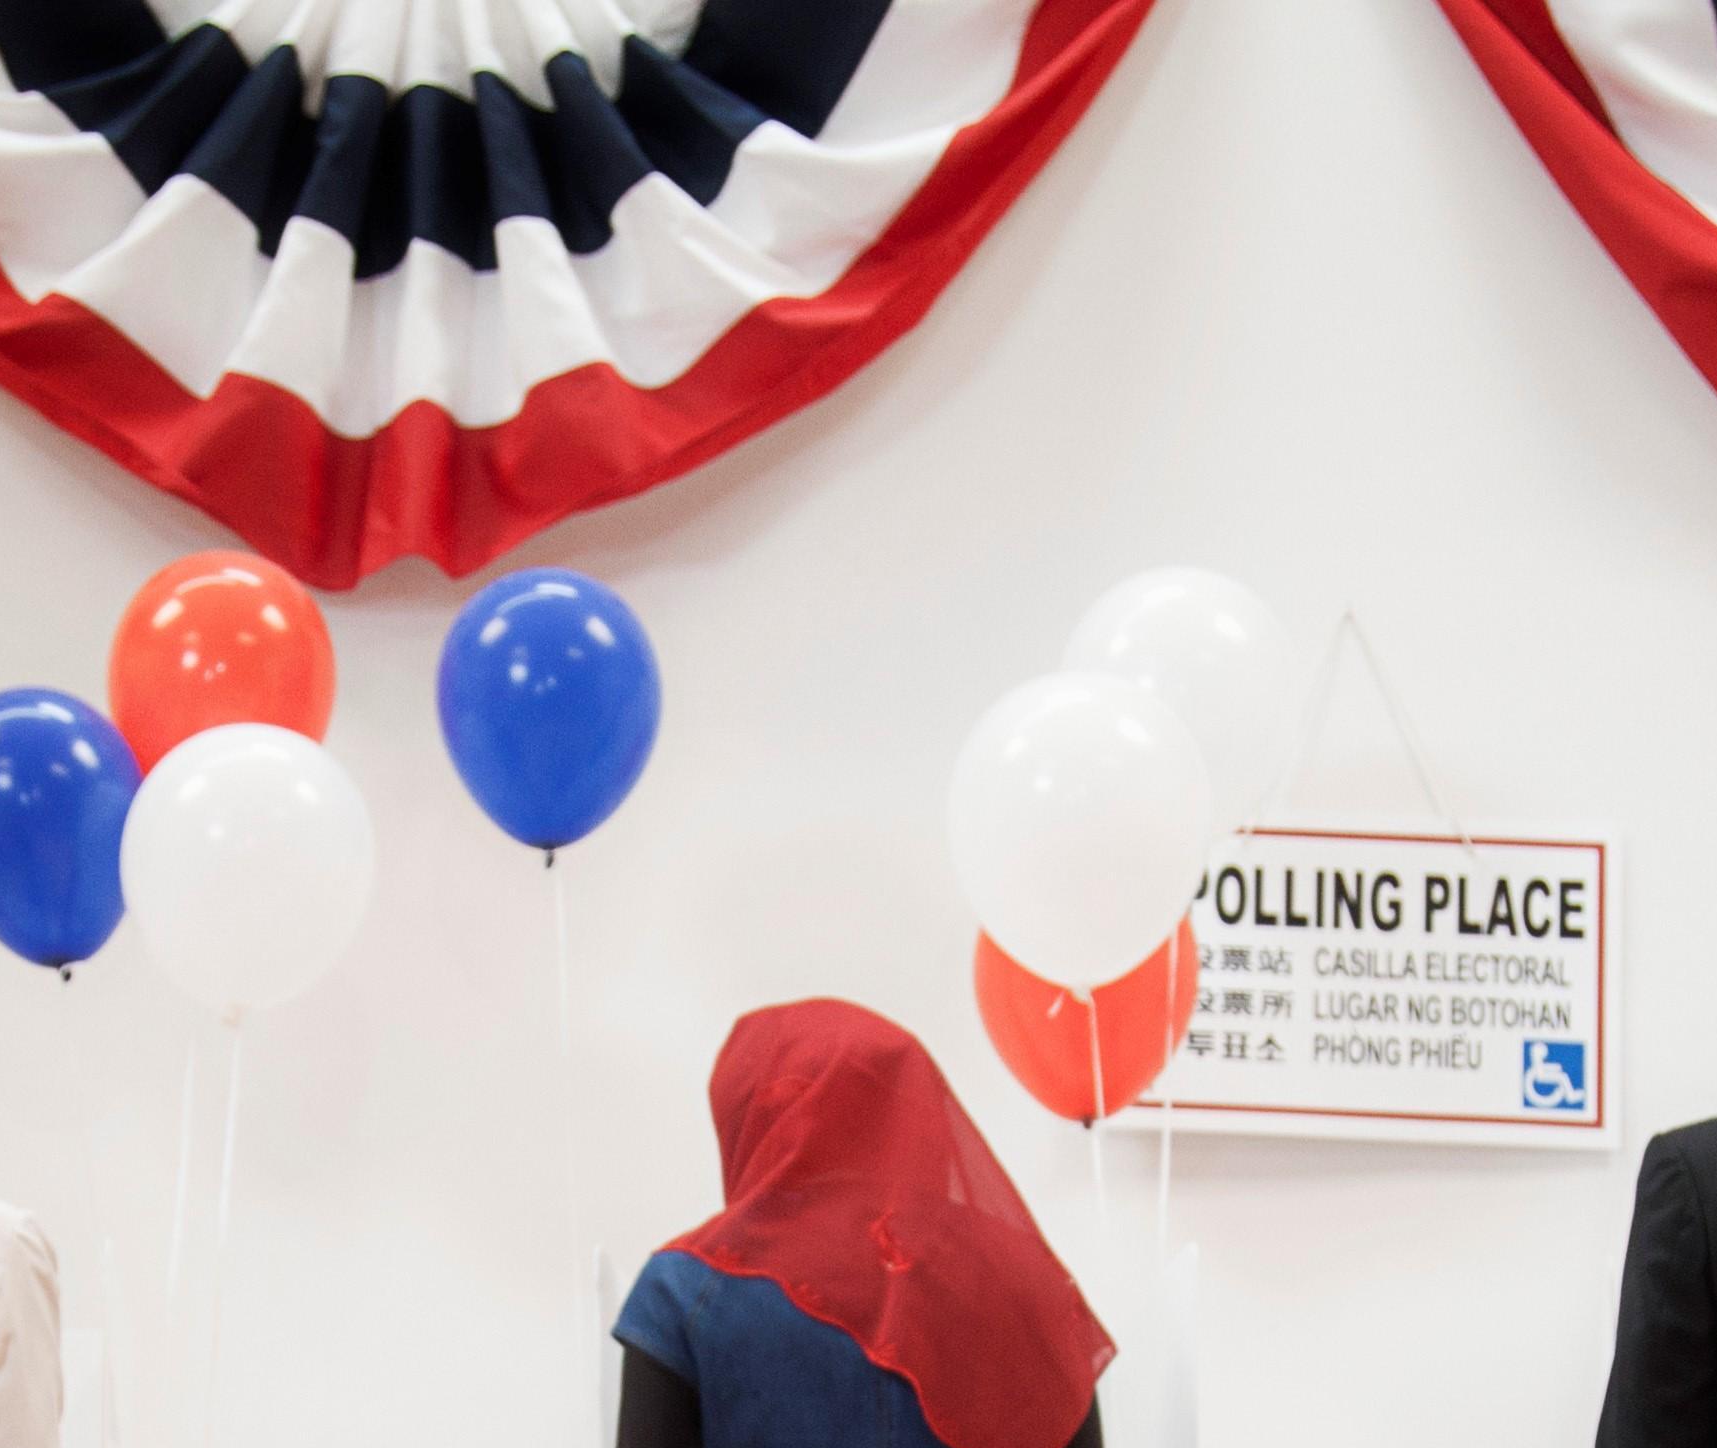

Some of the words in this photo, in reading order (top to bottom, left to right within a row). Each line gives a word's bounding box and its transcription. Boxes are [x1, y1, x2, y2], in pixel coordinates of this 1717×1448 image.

[1425, 875, 1585, 939] PLACE
[1314, 947, 1417, 981] CASILLA
[1425, 952, 1571, 988] ELECTORAL
[1314, 992, 1398, 1024] LUGAR
[1407, 996, 1442, 1026] NG
[1451, 998, 1572, 1030] BOTOHAN
[1314, 1029, 1401, 1066] PHÒNG
